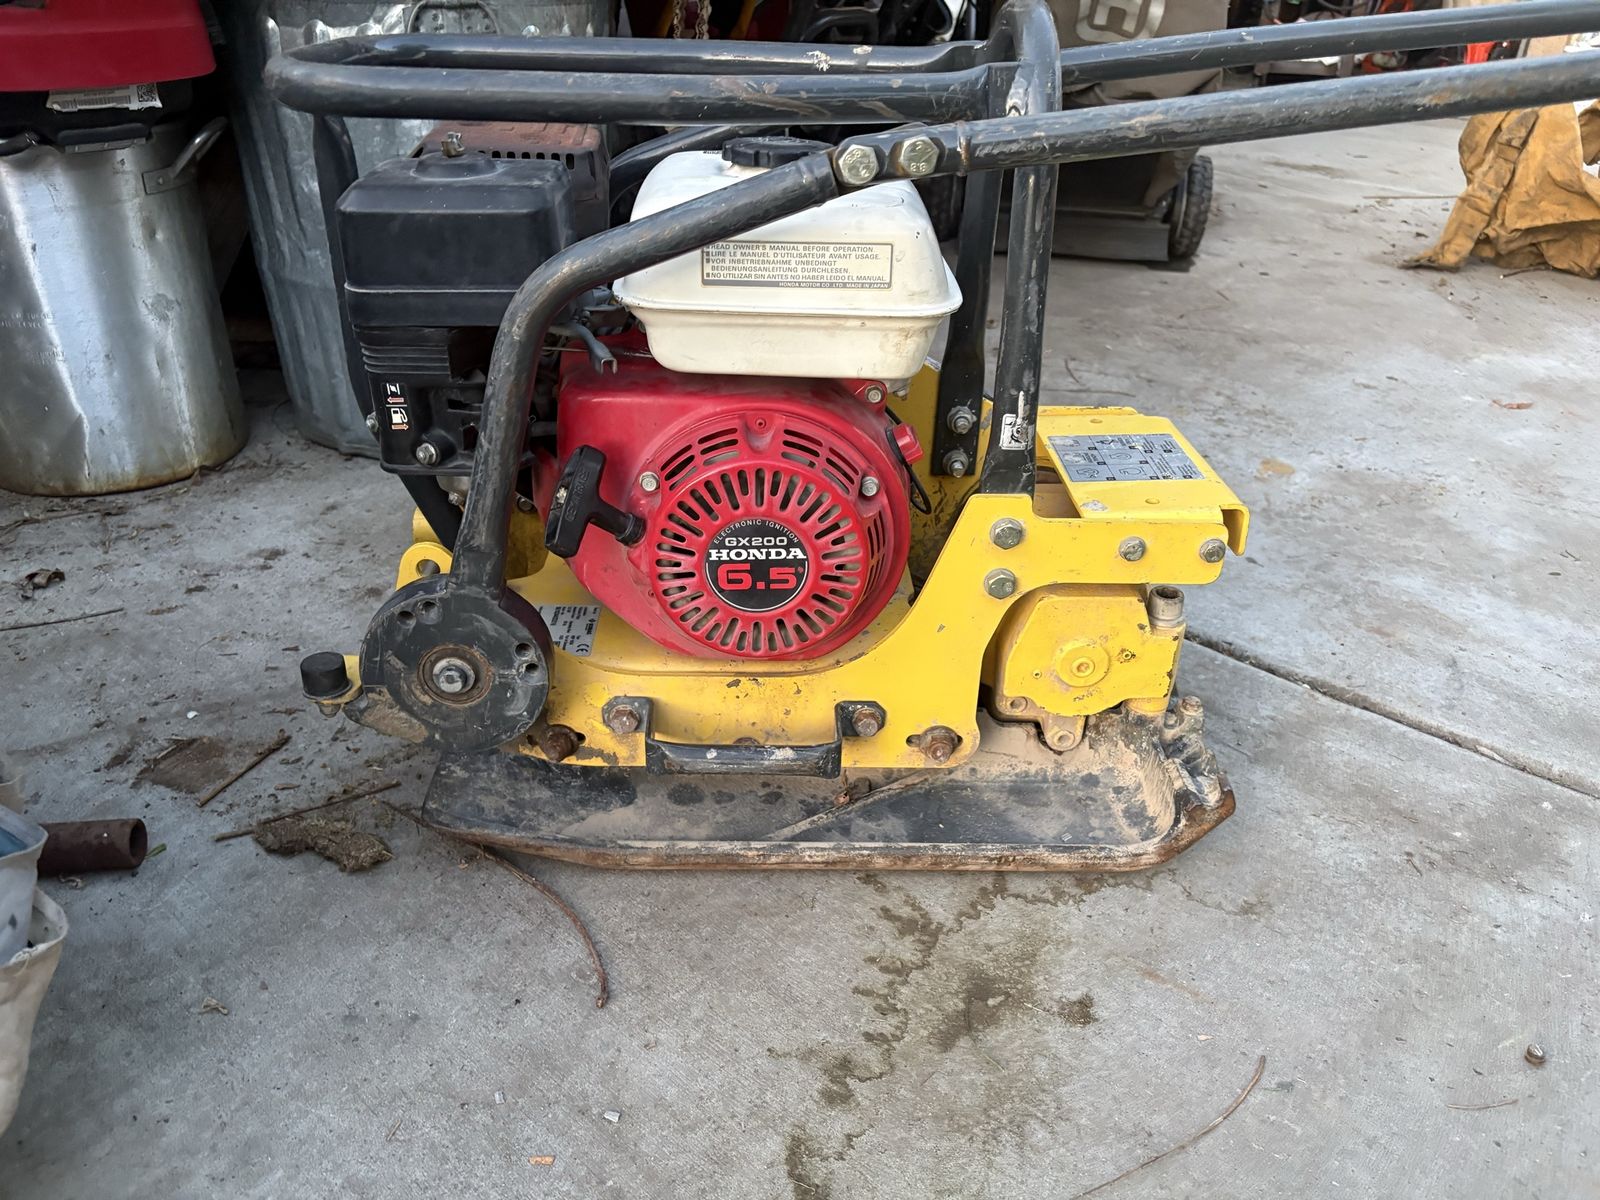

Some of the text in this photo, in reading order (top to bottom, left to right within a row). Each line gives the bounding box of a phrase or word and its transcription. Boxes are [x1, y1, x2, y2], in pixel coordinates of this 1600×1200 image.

[713, 519, 799, 544] ELECTRONIC IGNITION
[725, 536, 788, 546] GX200
[708, 548, 807, 561] HONDA
[717, 563, 797, 591] 6.5
